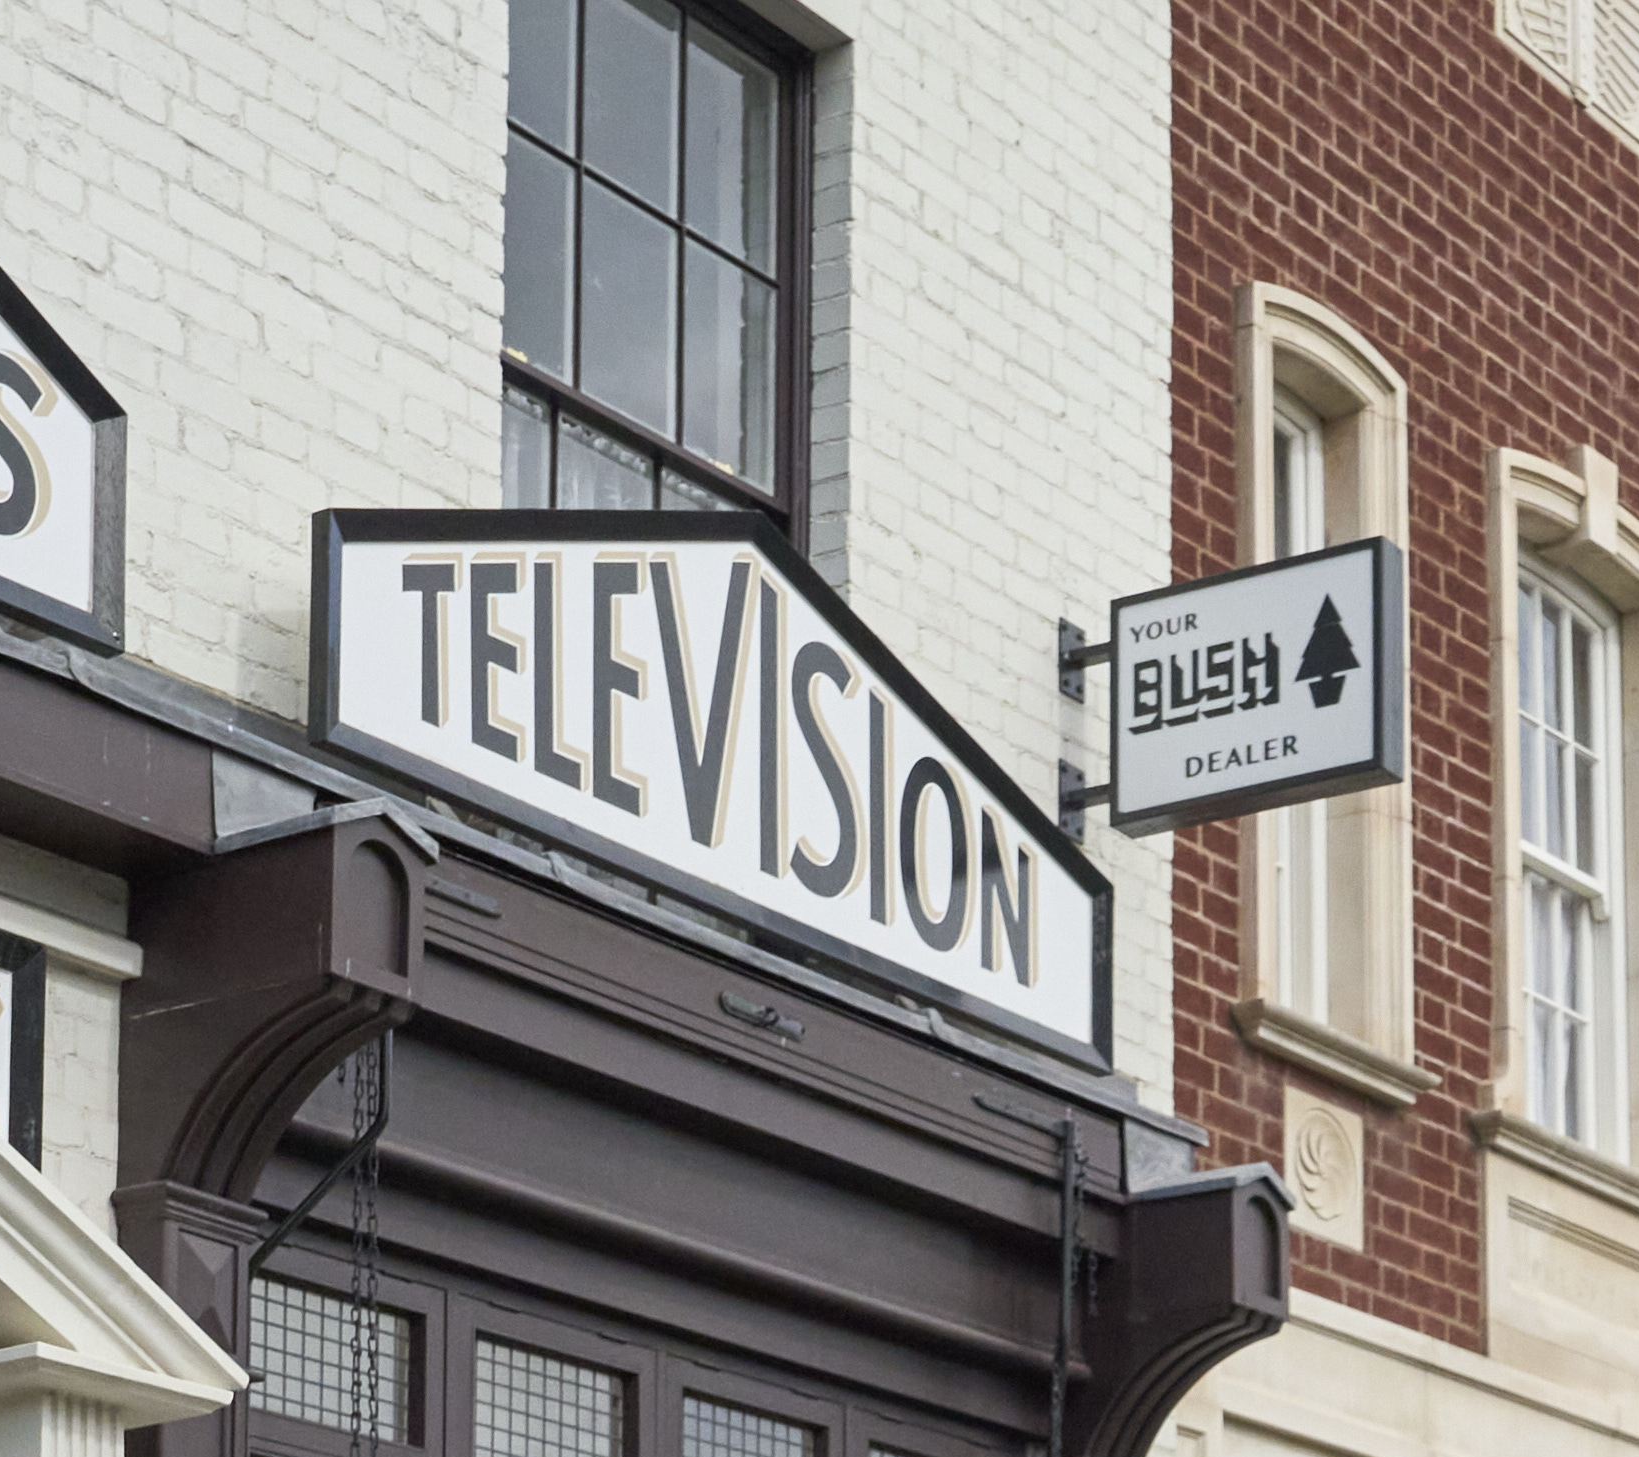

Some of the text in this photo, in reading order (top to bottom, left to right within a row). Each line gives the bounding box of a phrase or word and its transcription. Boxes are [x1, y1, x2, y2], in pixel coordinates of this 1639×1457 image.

[1129, 612, 1199, 644] YOUR
[1128, 632, 1281, 735] BUSH
[402, 552, 1039, 988] TELEVISION
[1185, 735, 1300, 779] DEALER
